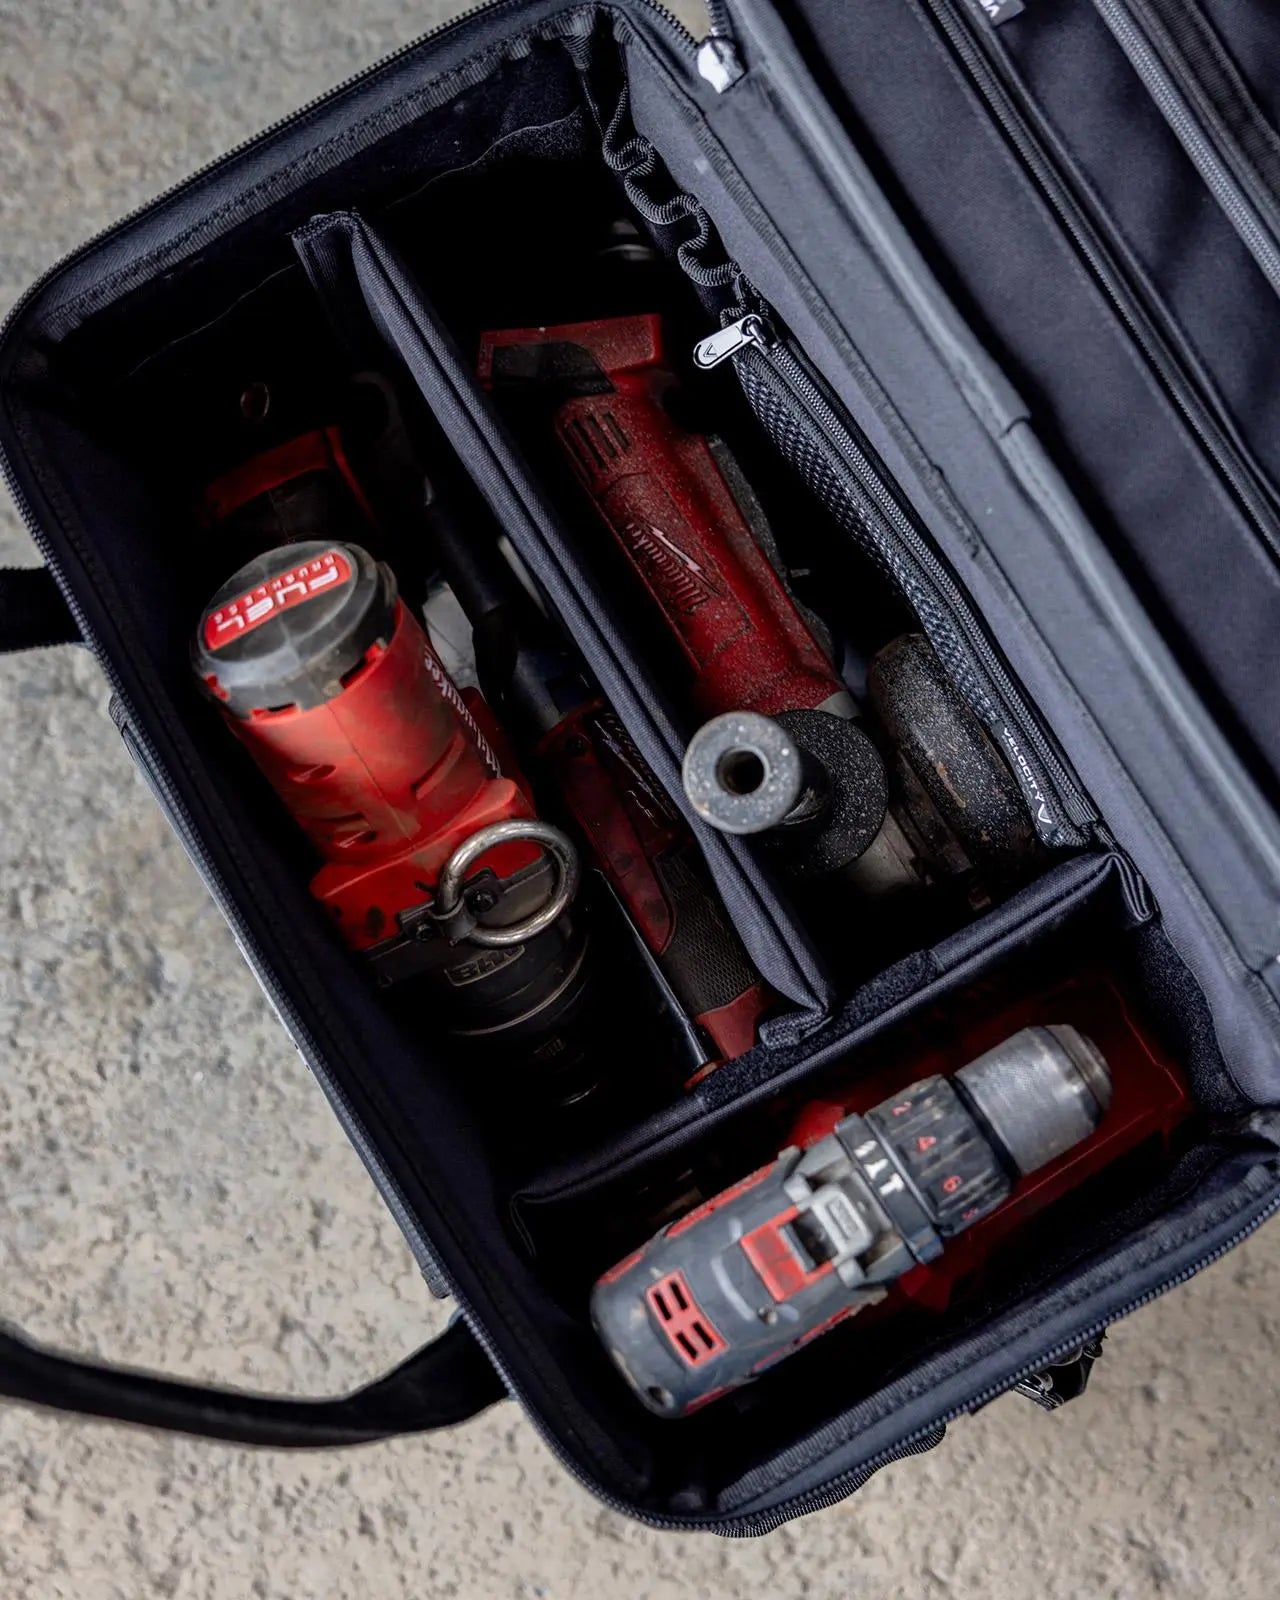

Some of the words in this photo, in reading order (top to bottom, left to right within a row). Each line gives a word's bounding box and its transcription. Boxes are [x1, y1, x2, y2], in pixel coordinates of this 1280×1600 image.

[214, 554, 335, 625] BRUSHLESS
[216, 565, 339, 632] FUEL
[1004, 727, 1045, 802] VELOCITY
[892, 1101, 912, 1116] 2
[917, 1135, 937, 1152] 4
[943, 1174, 962, 1192] 6
